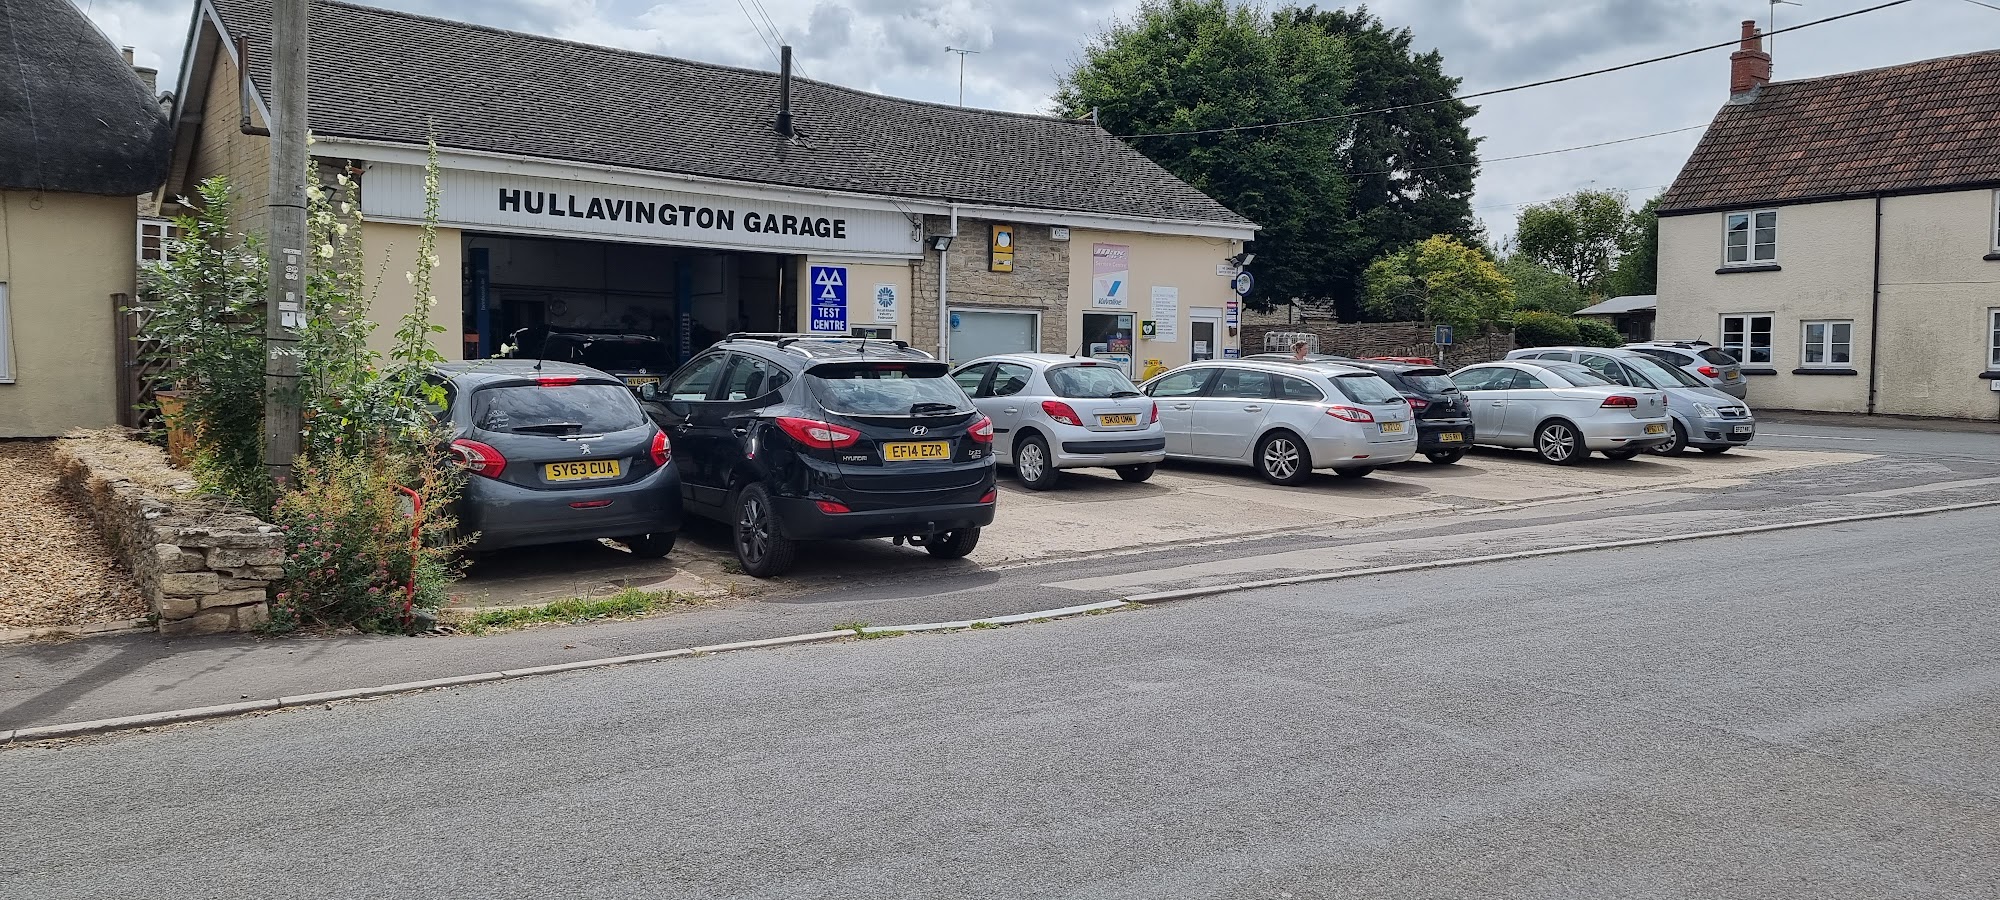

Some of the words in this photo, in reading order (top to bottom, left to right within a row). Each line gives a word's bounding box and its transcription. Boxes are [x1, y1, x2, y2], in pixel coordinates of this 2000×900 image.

[499, 187, 735, 231] HULLAVINGTON
[743, 211, 846, 239] GARAGE
[818, 307, 840, 318] TEST
[813, 319, 844, 330] CENTRE
[892, 445, 918, 458] EF14
[921, 444, 942, 457] EZR
[552, 462, 587, 476] SY63
[590, 462, 614, 474] CUA
